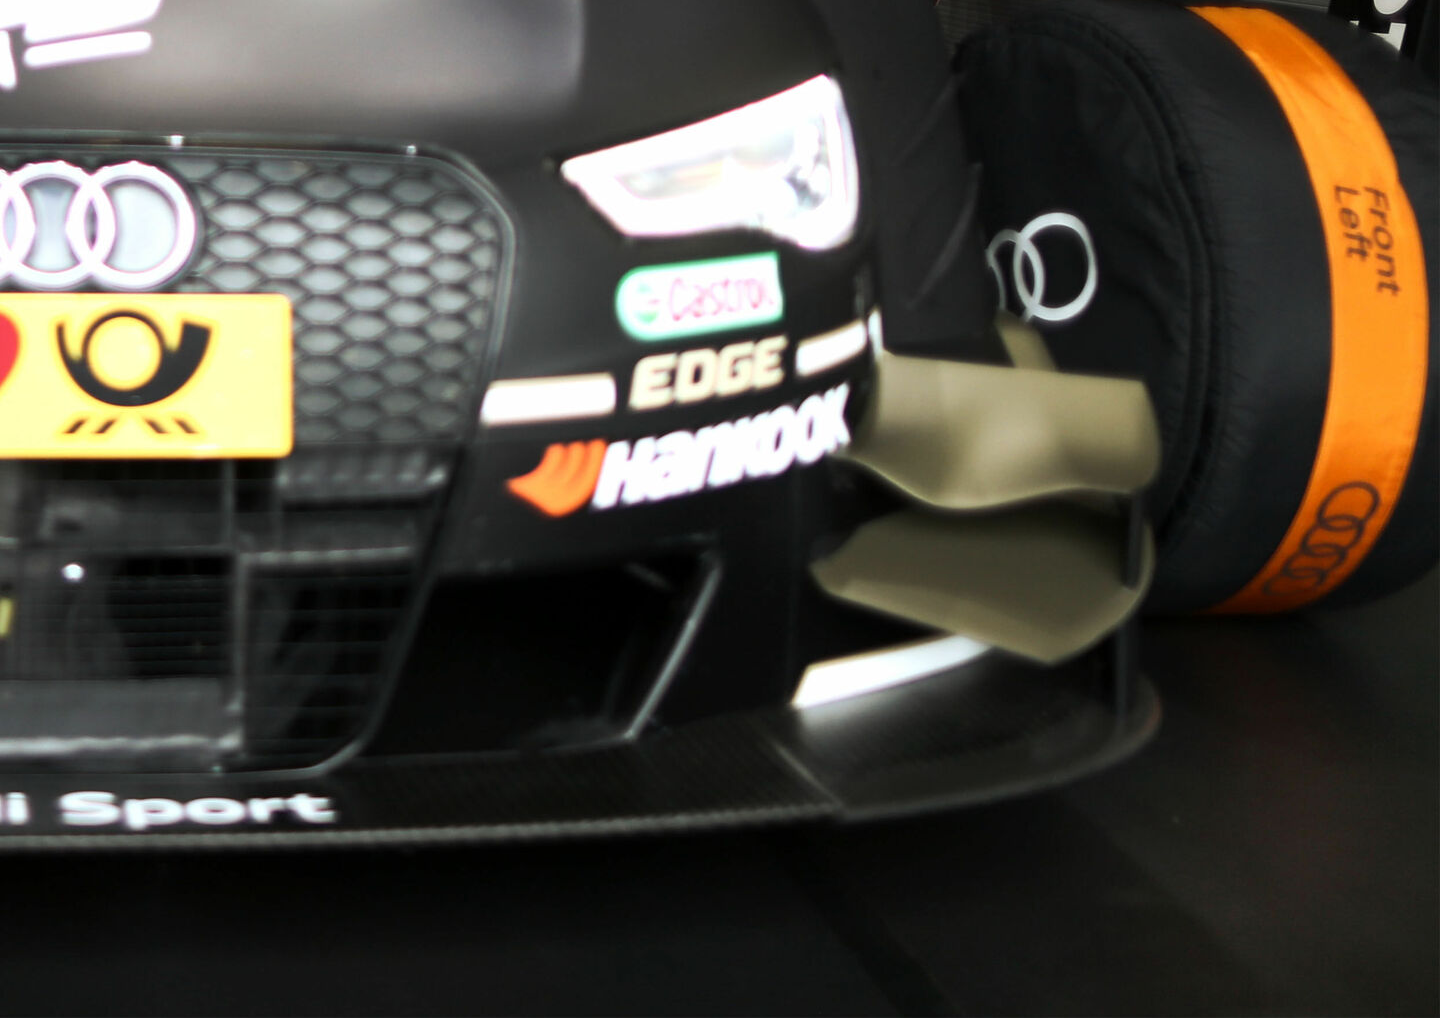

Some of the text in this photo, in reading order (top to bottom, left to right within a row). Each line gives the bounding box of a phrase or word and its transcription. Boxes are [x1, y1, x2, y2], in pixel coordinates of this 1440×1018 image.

[1333, 184, 1371, 262] Left
[1362, 185, 1399, 297] Front
[629, 335, 788, 410] EDGE
[58, 791, 337, 830] Sport
